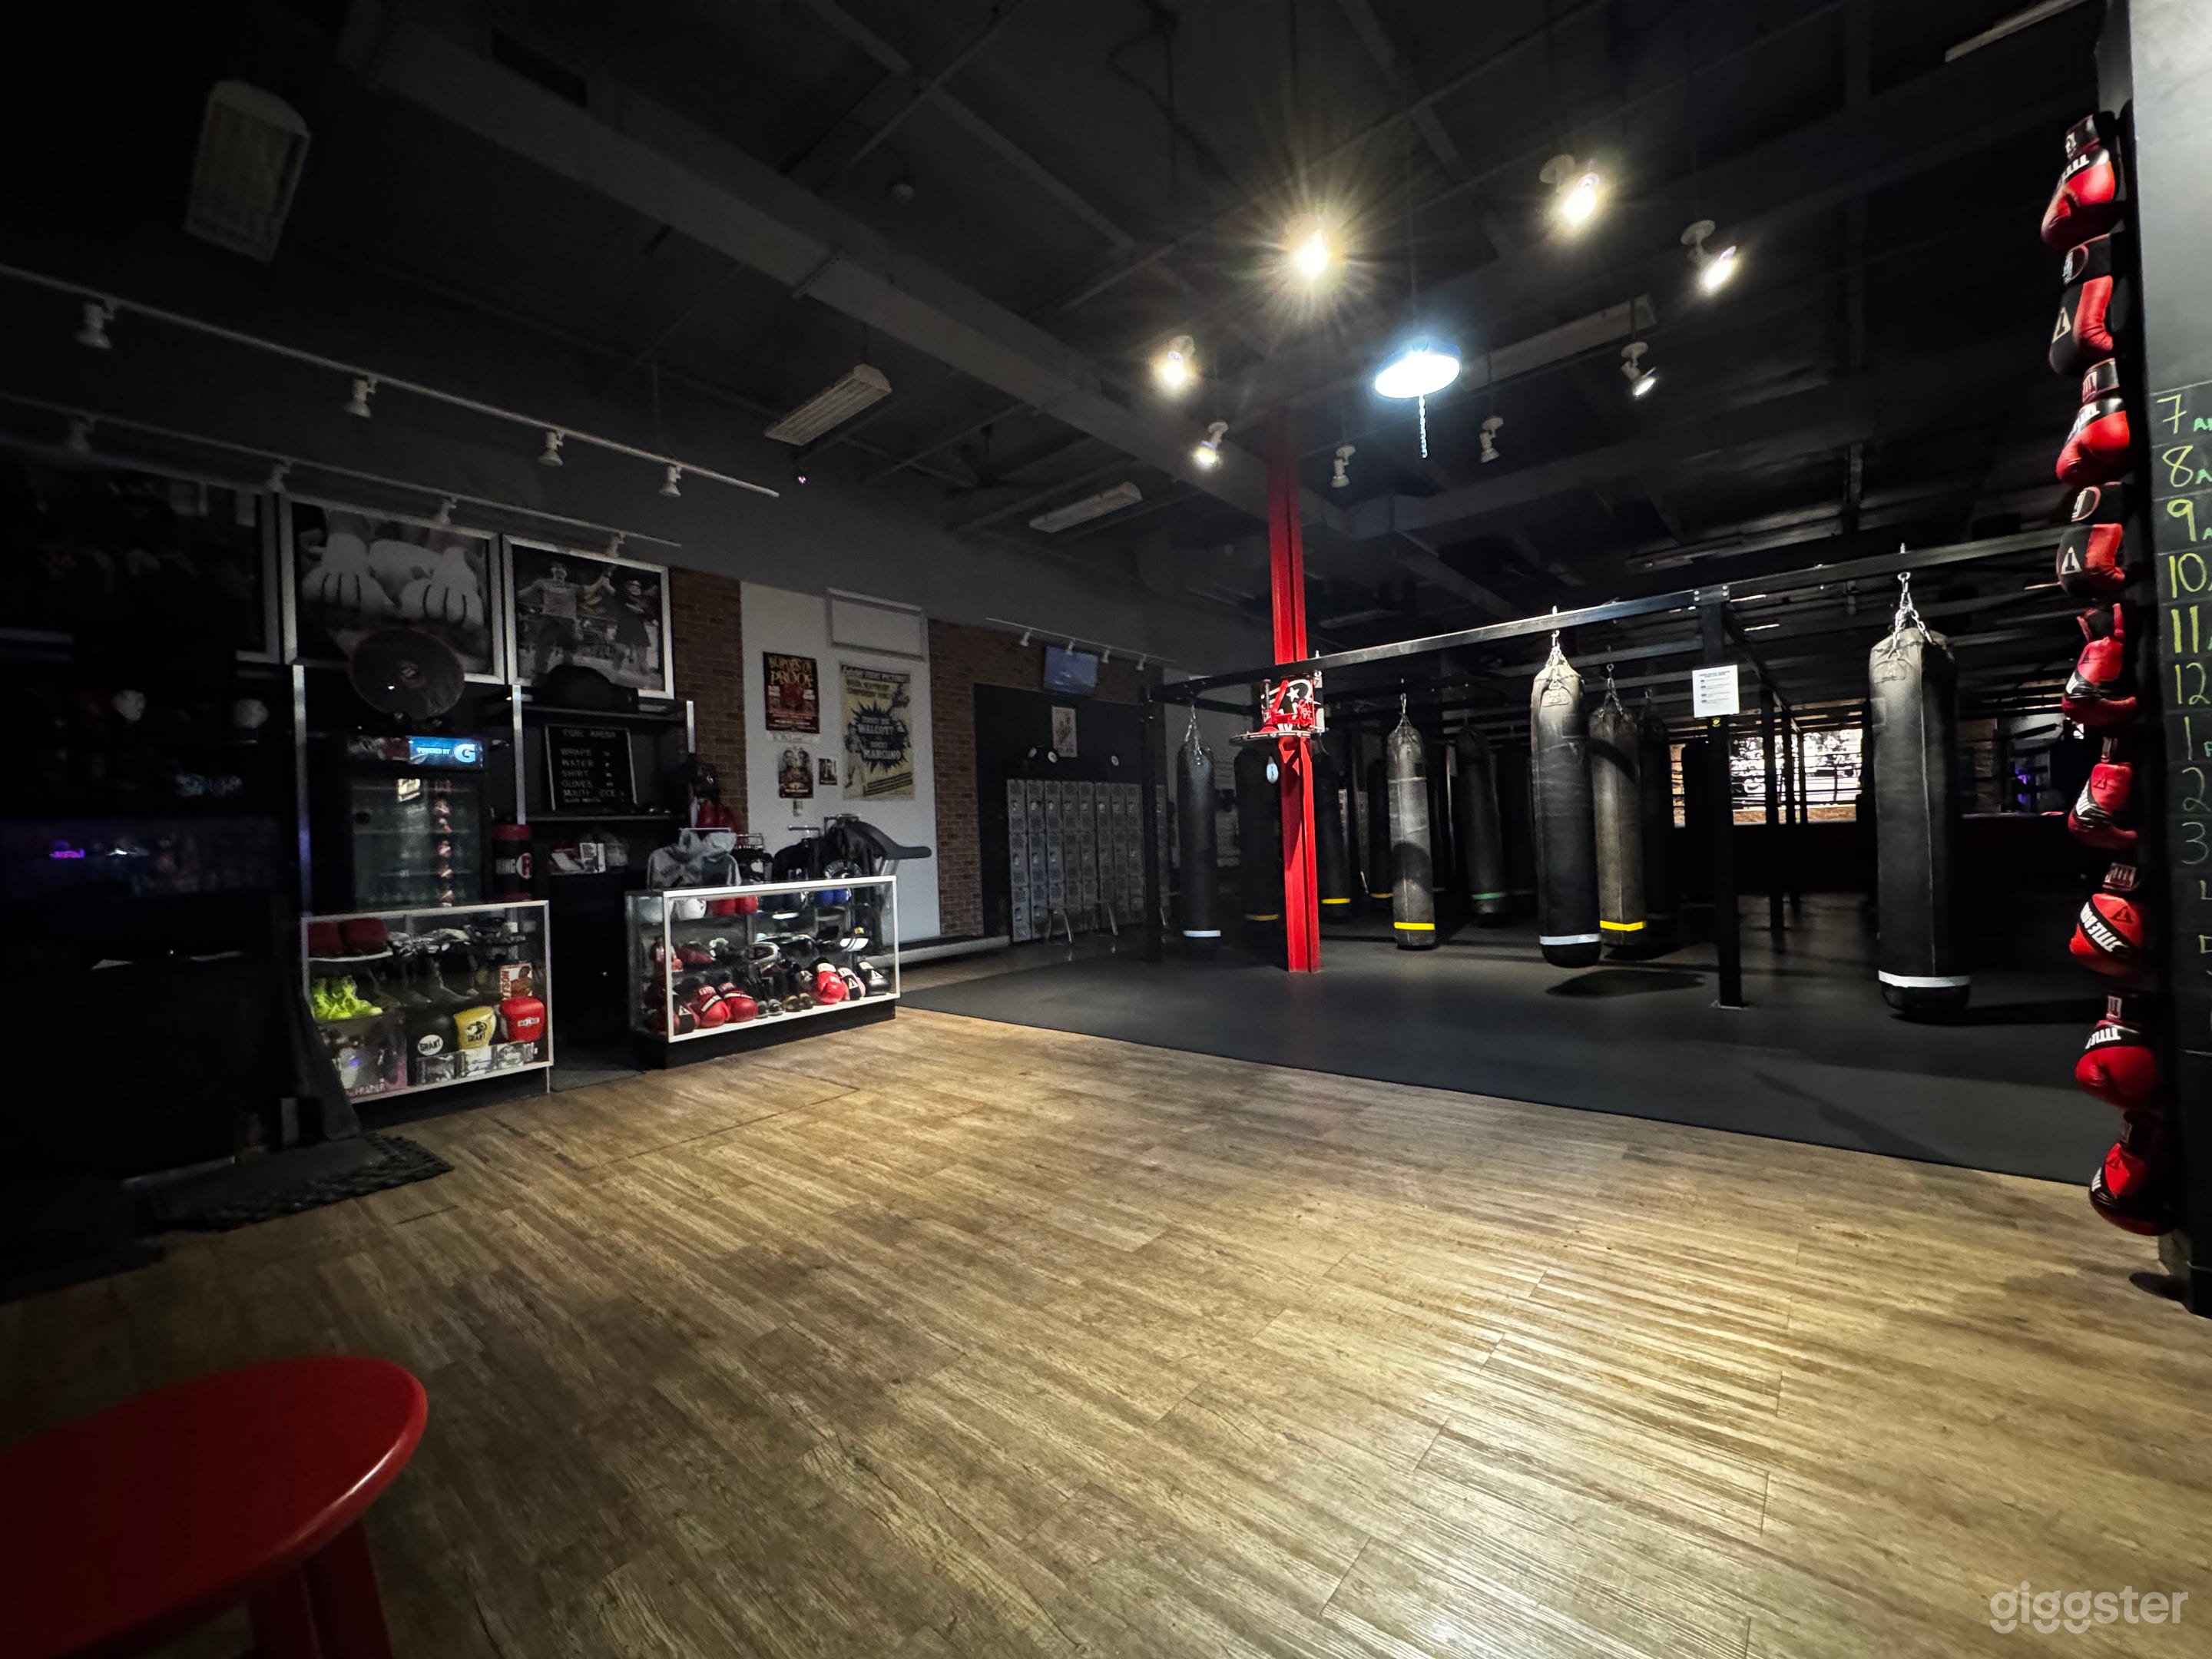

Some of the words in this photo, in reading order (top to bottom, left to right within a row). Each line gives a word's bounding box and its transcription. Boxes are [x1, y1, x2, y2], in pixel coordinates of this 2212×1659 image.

[2156, 394, 2187, 435] 7
[2161, 445, 2194, 488] 8
[2167, 499, 2197, 541] 9
[2169, 552, 2207, 598] 10
[2171, 604, 2199, 654] 11
[2174, 662, 2211, 705] 12
[858, 724, 895, 735] WALCOTT
[453, 743, 476, 763] G
[561, 759, 594, 768] WATER
[2181, 767, 2212, 811] 2
[2181, 822, 2209, 865] 3
[419, 1038, 440, 1051] GRANT
